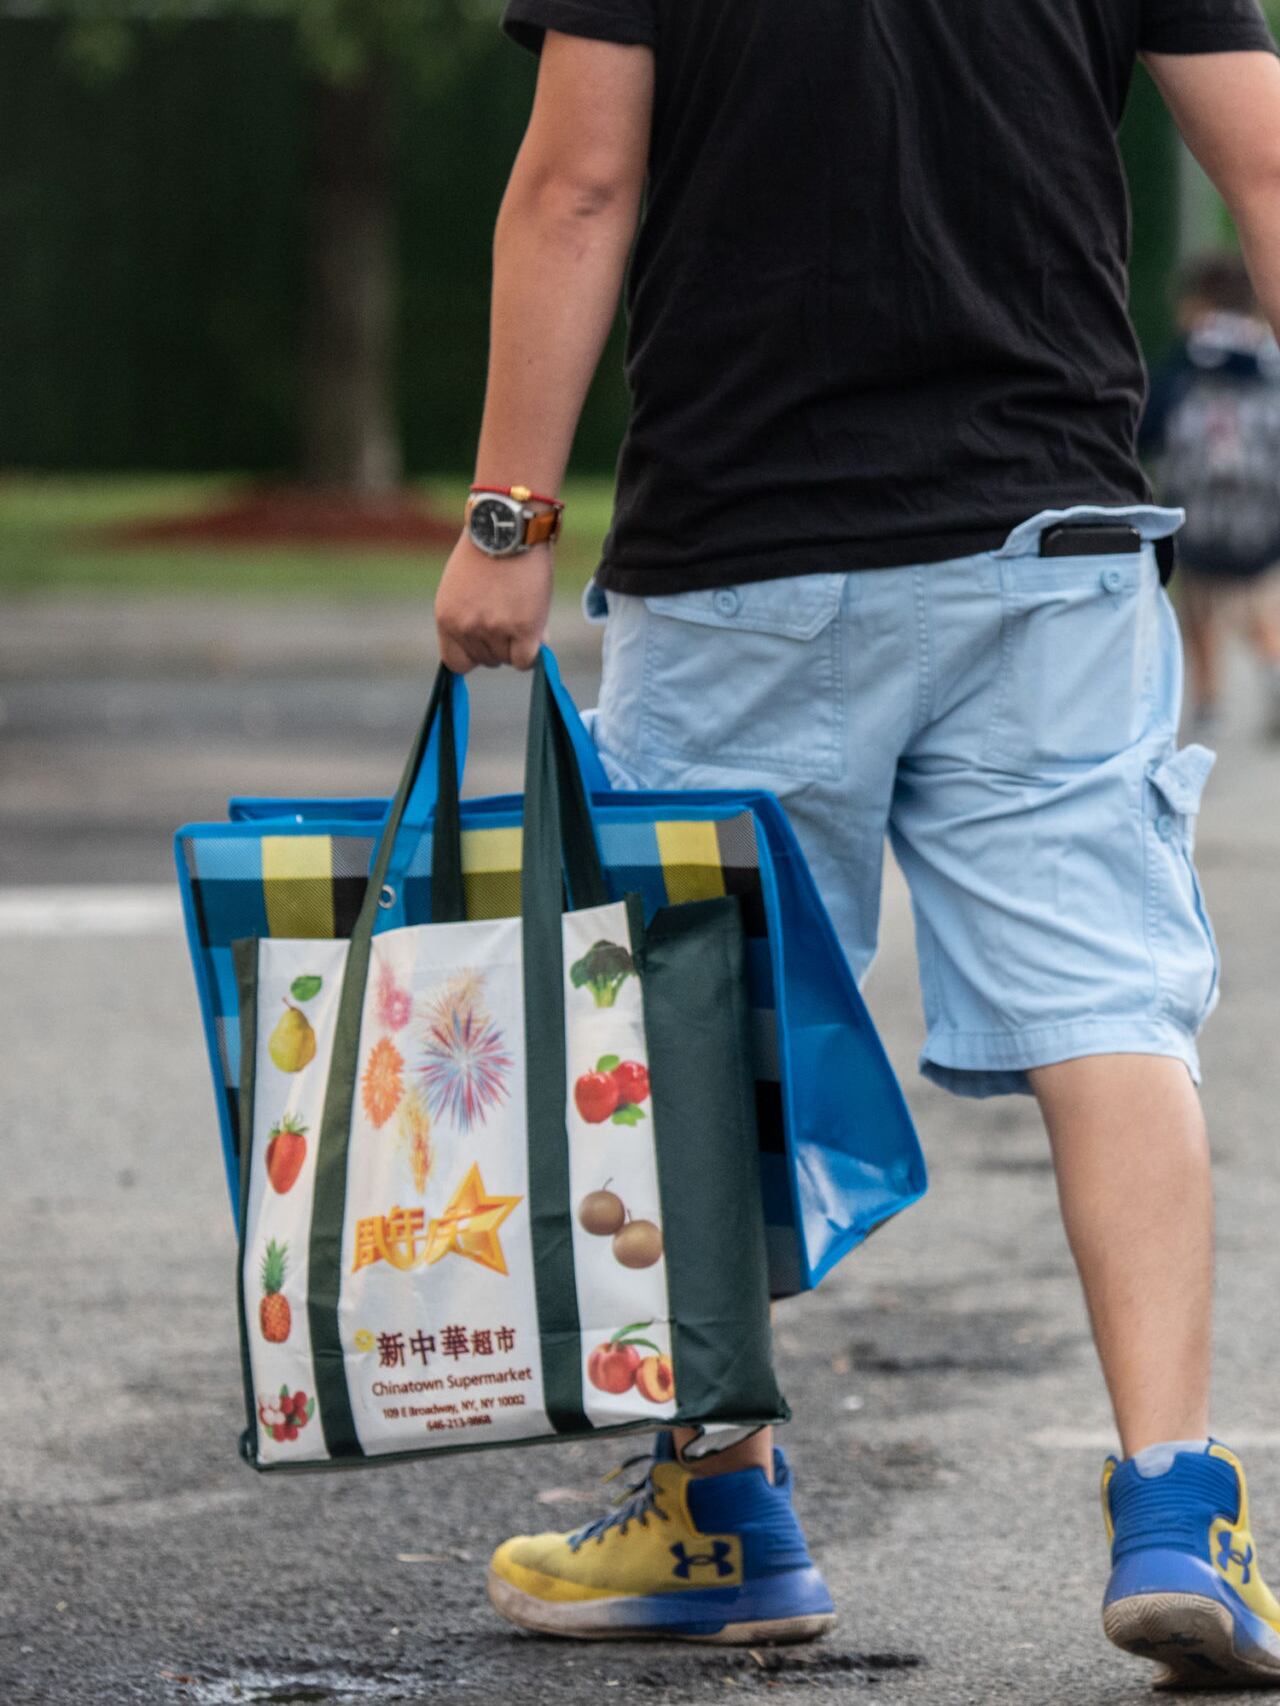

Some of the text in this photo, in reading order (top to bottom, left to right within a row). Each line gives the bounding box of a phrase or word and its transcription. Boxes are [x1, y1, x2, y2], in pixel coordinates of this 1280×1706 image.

[376, 1323, 516, 1368] 新中華超市
[372, 1367, 533, 1396] Chinatown Supermarket
[461, 1399, 479, 1412] NY,
[480, 1397, 494, 1408] NY
